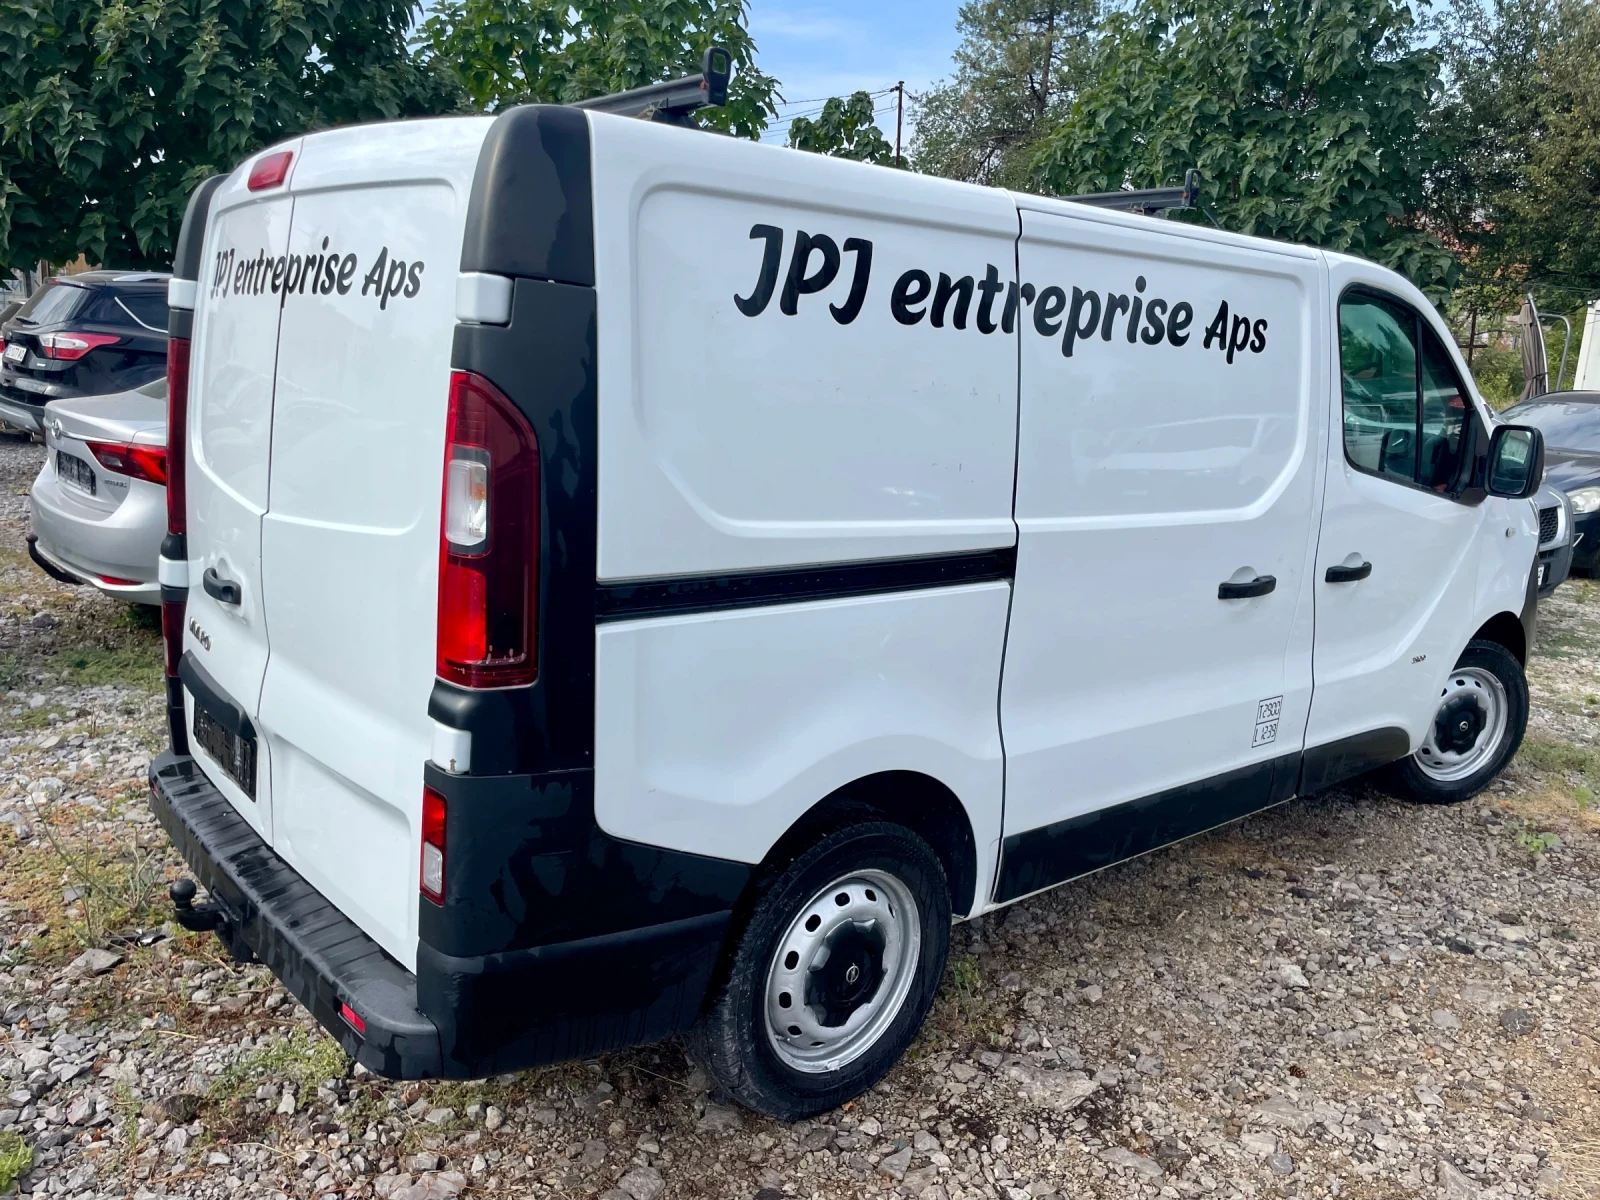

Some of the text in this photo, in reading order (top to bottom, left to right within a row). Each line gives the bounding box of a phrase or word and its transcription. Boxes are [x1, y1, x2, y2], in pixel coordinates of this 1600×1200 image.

[210, 235, 426, 311] JPJ entreprise Aps
[733, 223, 1268, 365] JPJ entreprise Aps
